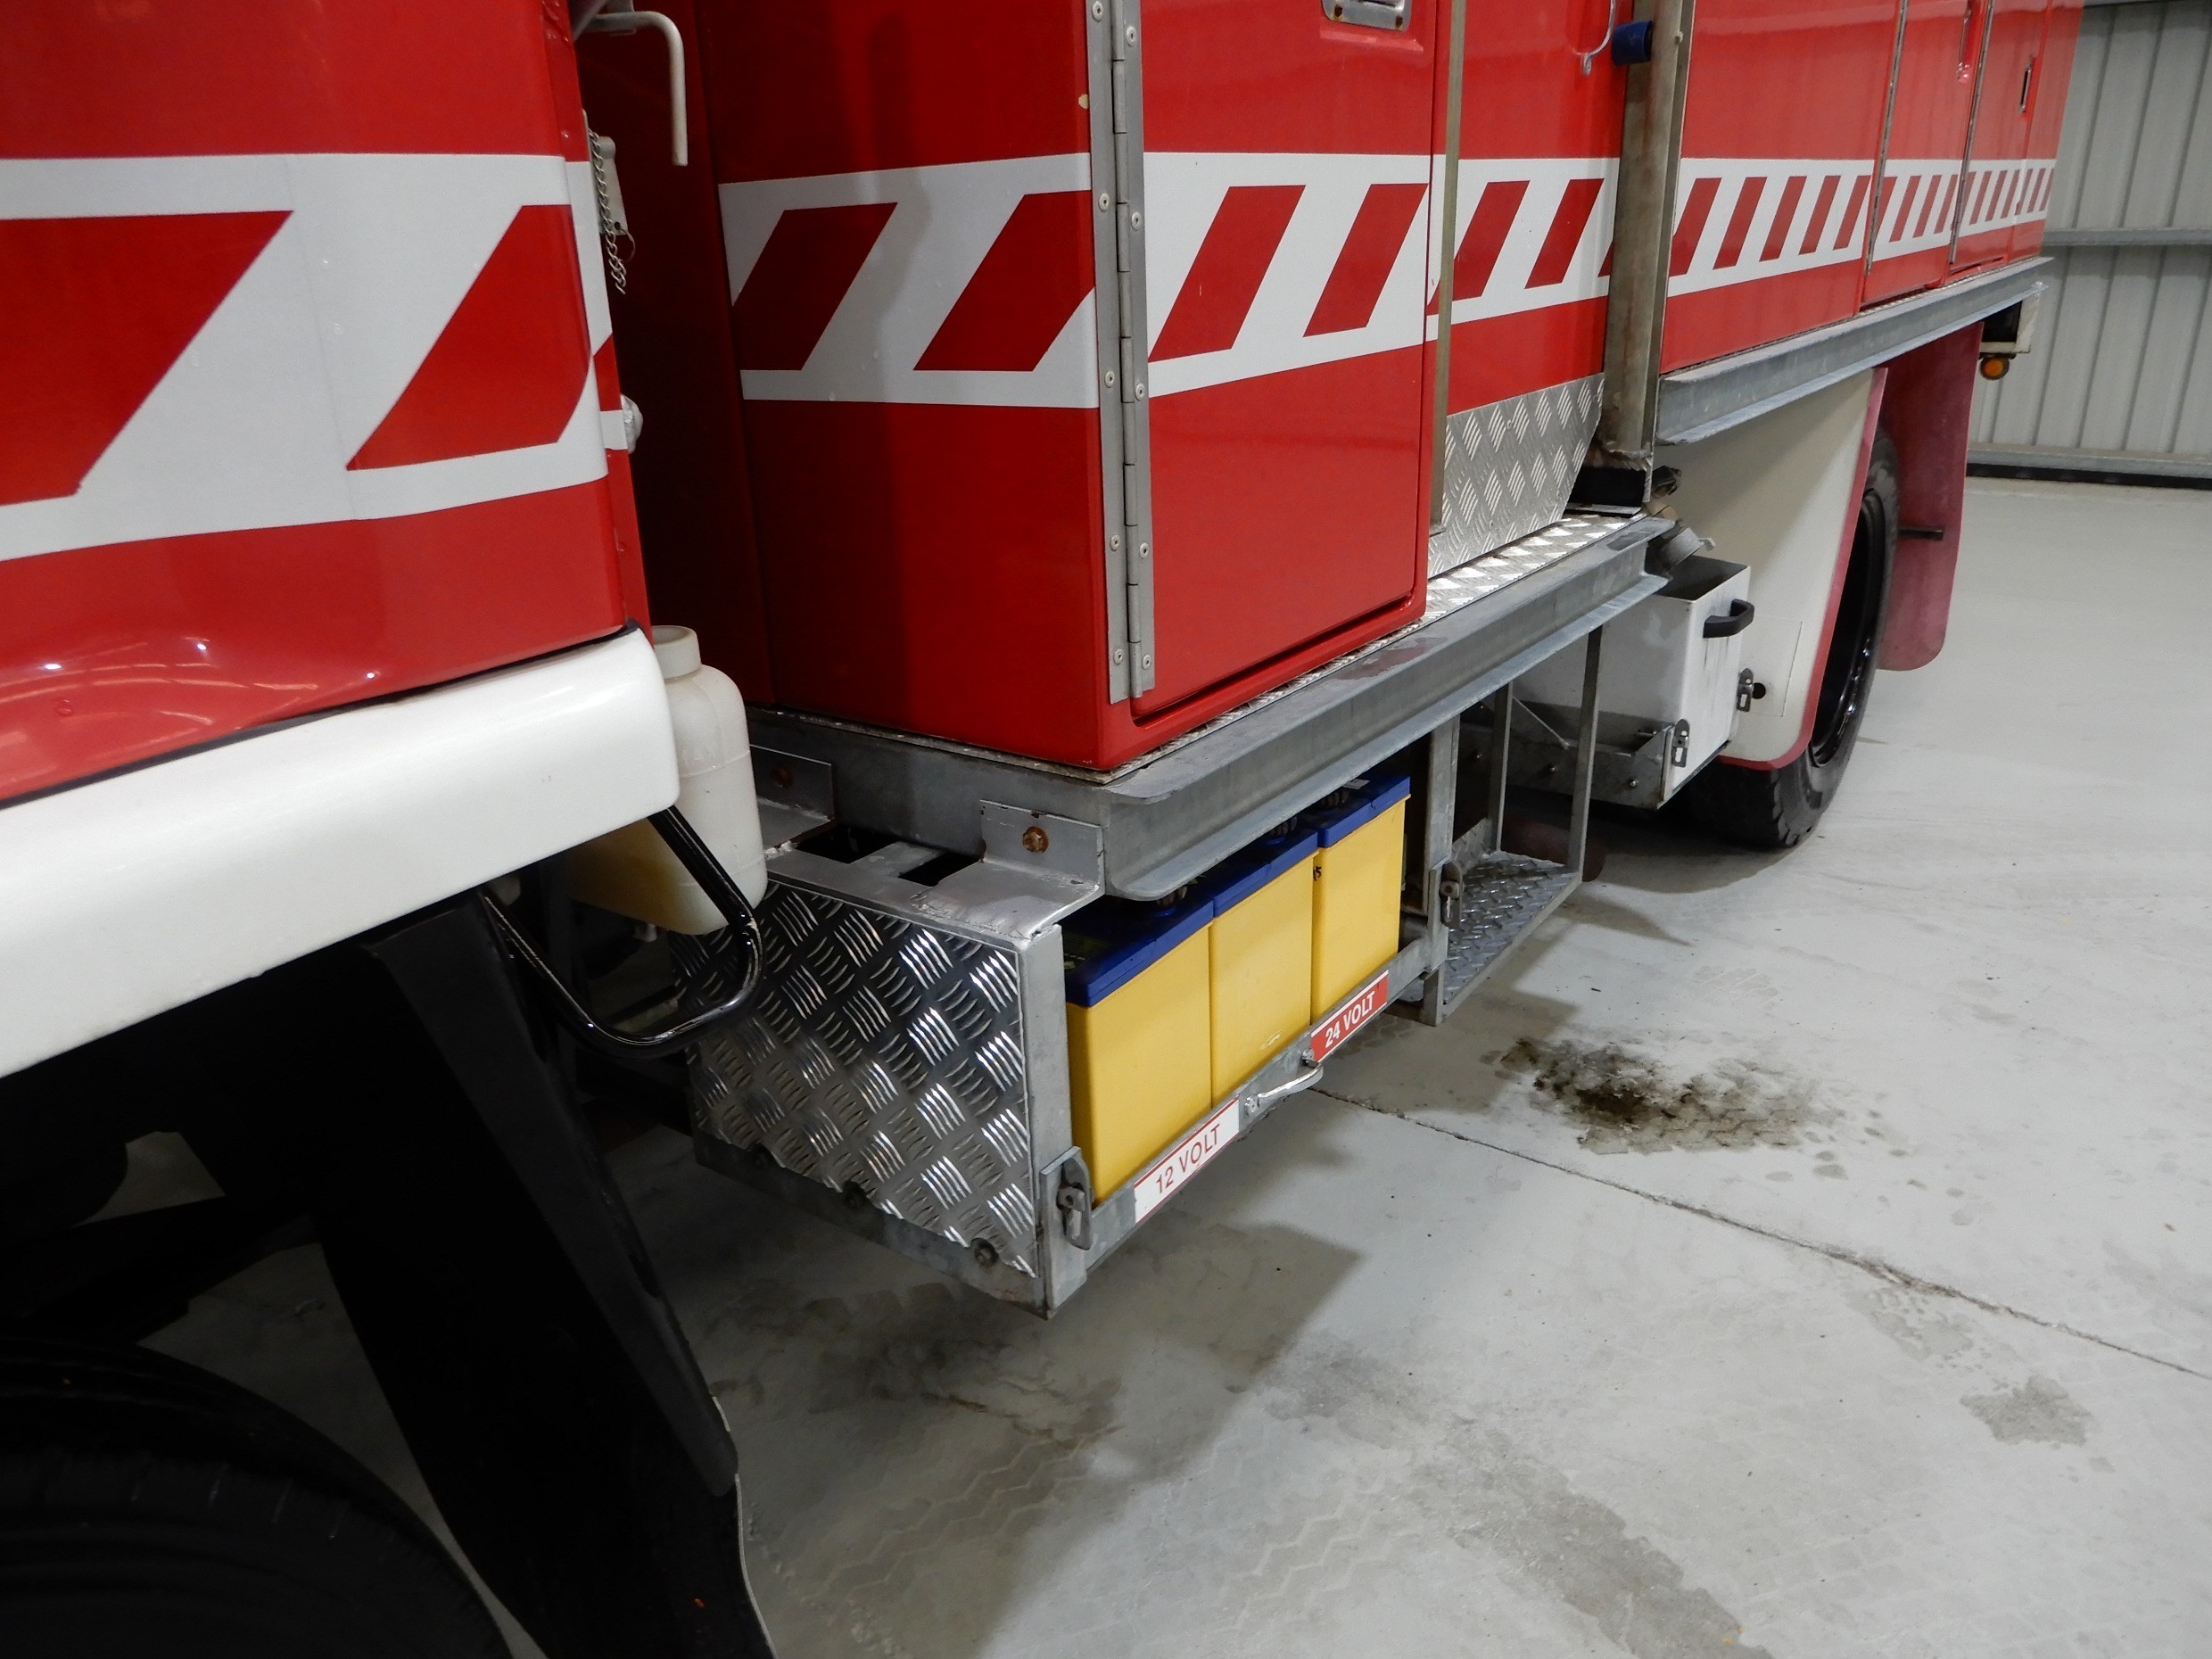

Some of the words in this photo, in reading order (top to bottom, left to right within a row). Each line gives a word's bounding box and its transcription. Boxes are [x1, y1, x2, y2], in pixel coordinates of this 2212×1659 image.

[1325, 1020, 1341, 1048] 24
[1342, 990, 1375, 1031] VOLT
[1156, 1166, 1174, 1193] 12
[1178, 1123, 1220, 1173] VOLT
